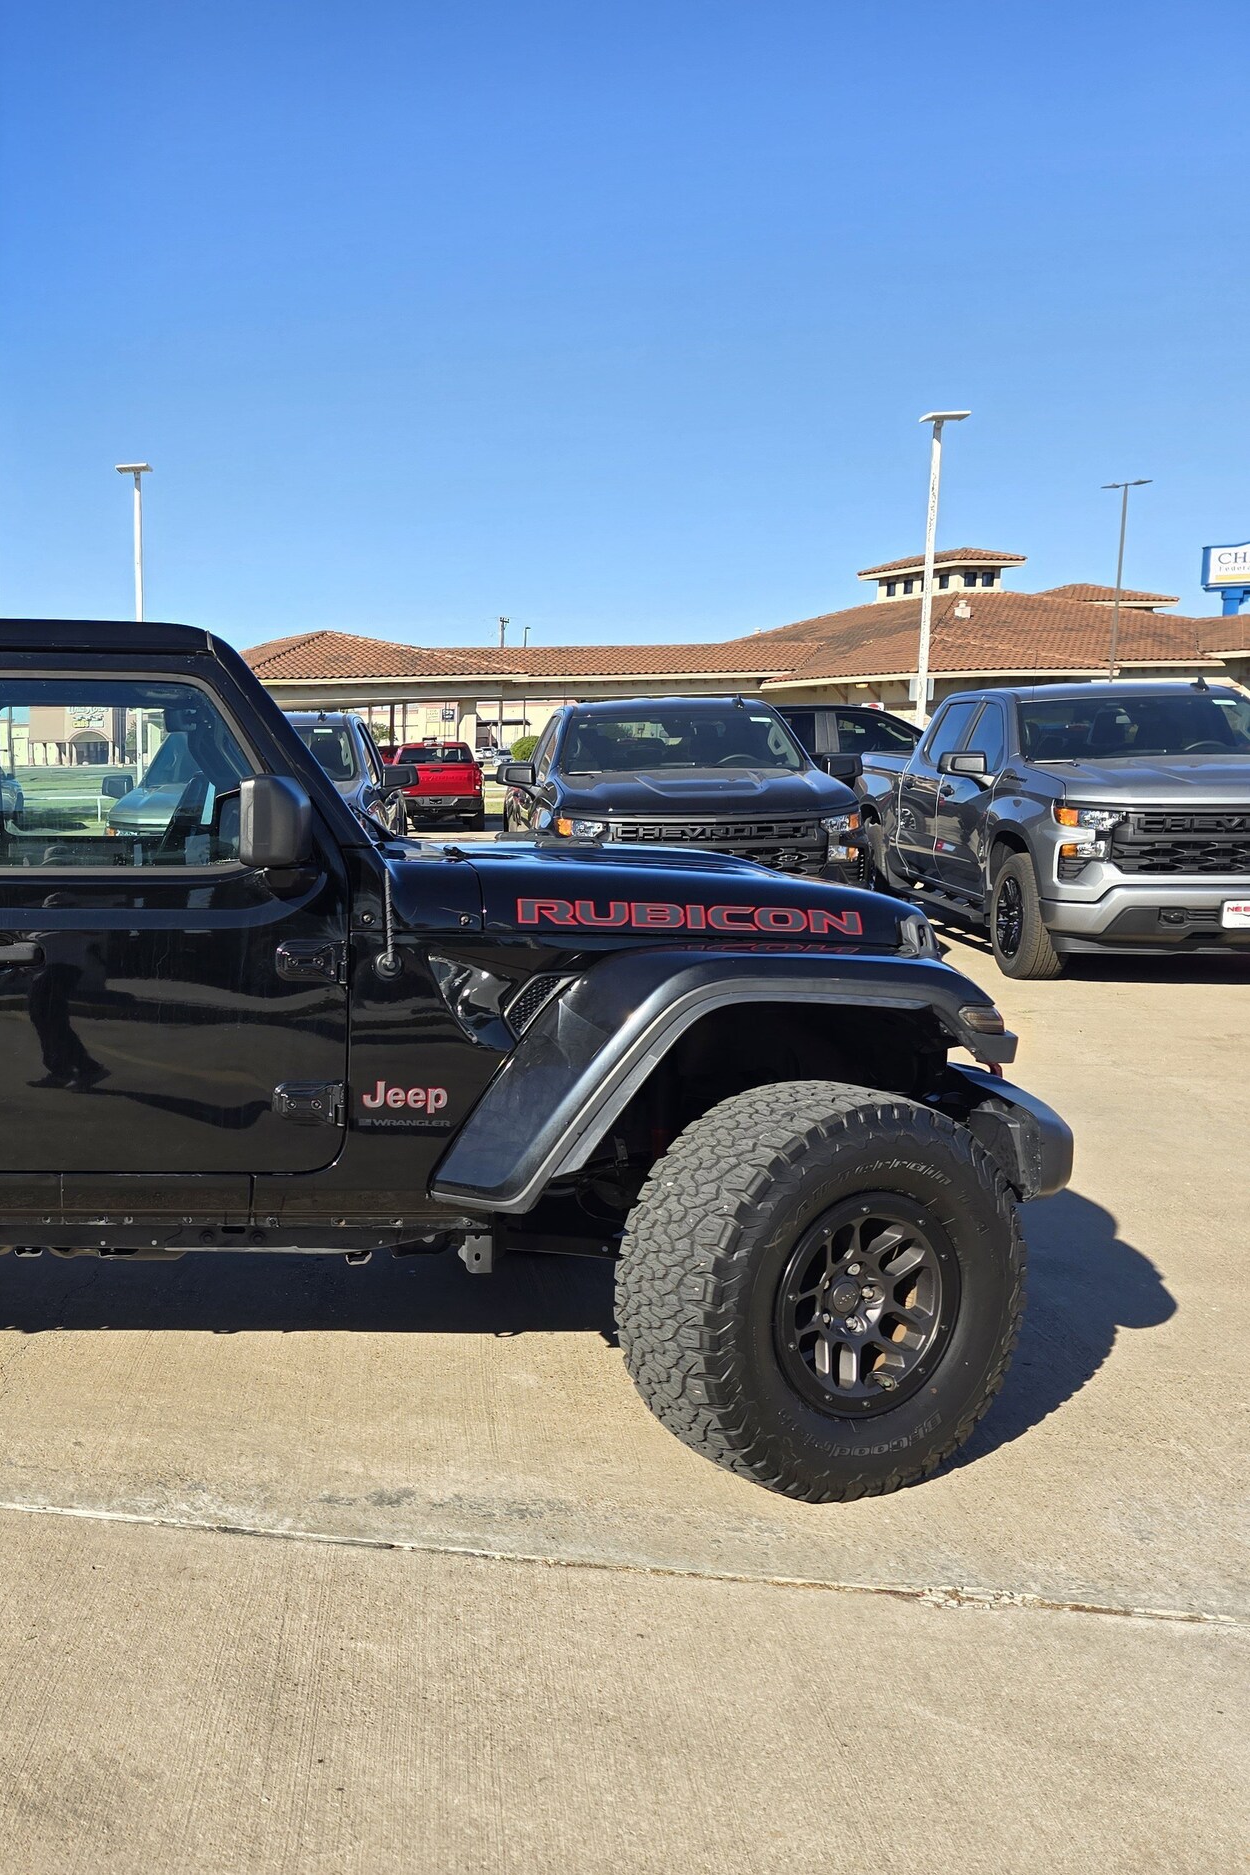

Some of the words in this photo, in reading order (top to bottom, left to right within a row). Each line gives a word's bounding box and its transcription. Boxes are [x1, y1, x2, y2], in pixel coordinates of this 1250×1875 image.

[1218, 551, 1250, 565] CH
[616, 824, 817, 839] CHEVROLET
[517, 898, 863, 936] RUBICON
[362, 1081, 448, 1114] Jeep
[373, 1118, 451, 1127] WRANGLER
